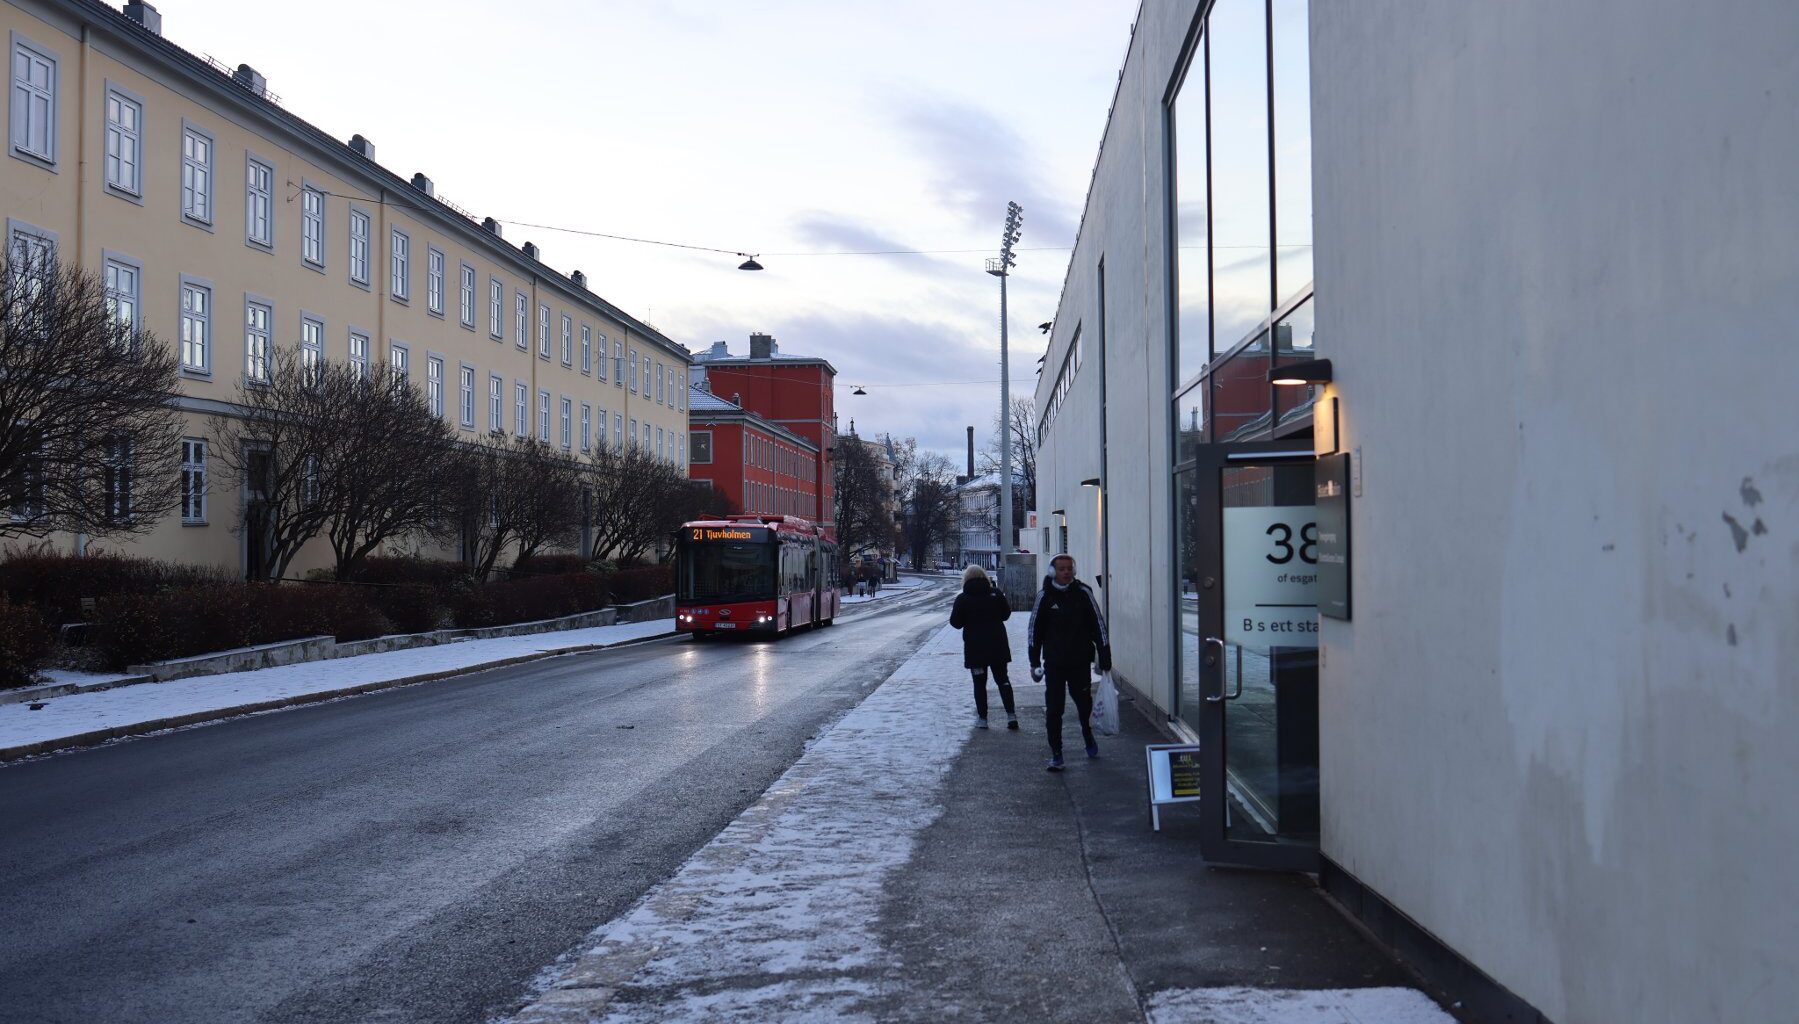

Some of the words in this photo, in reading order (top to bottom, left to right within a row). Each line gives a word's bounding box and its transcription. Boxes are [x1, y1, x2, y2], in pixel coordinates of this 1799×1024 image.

[693, 529, 703, 540] 21
[707, 529, 751, 539] Tjuvholmen
[1277, 573, 1288, 583] of
